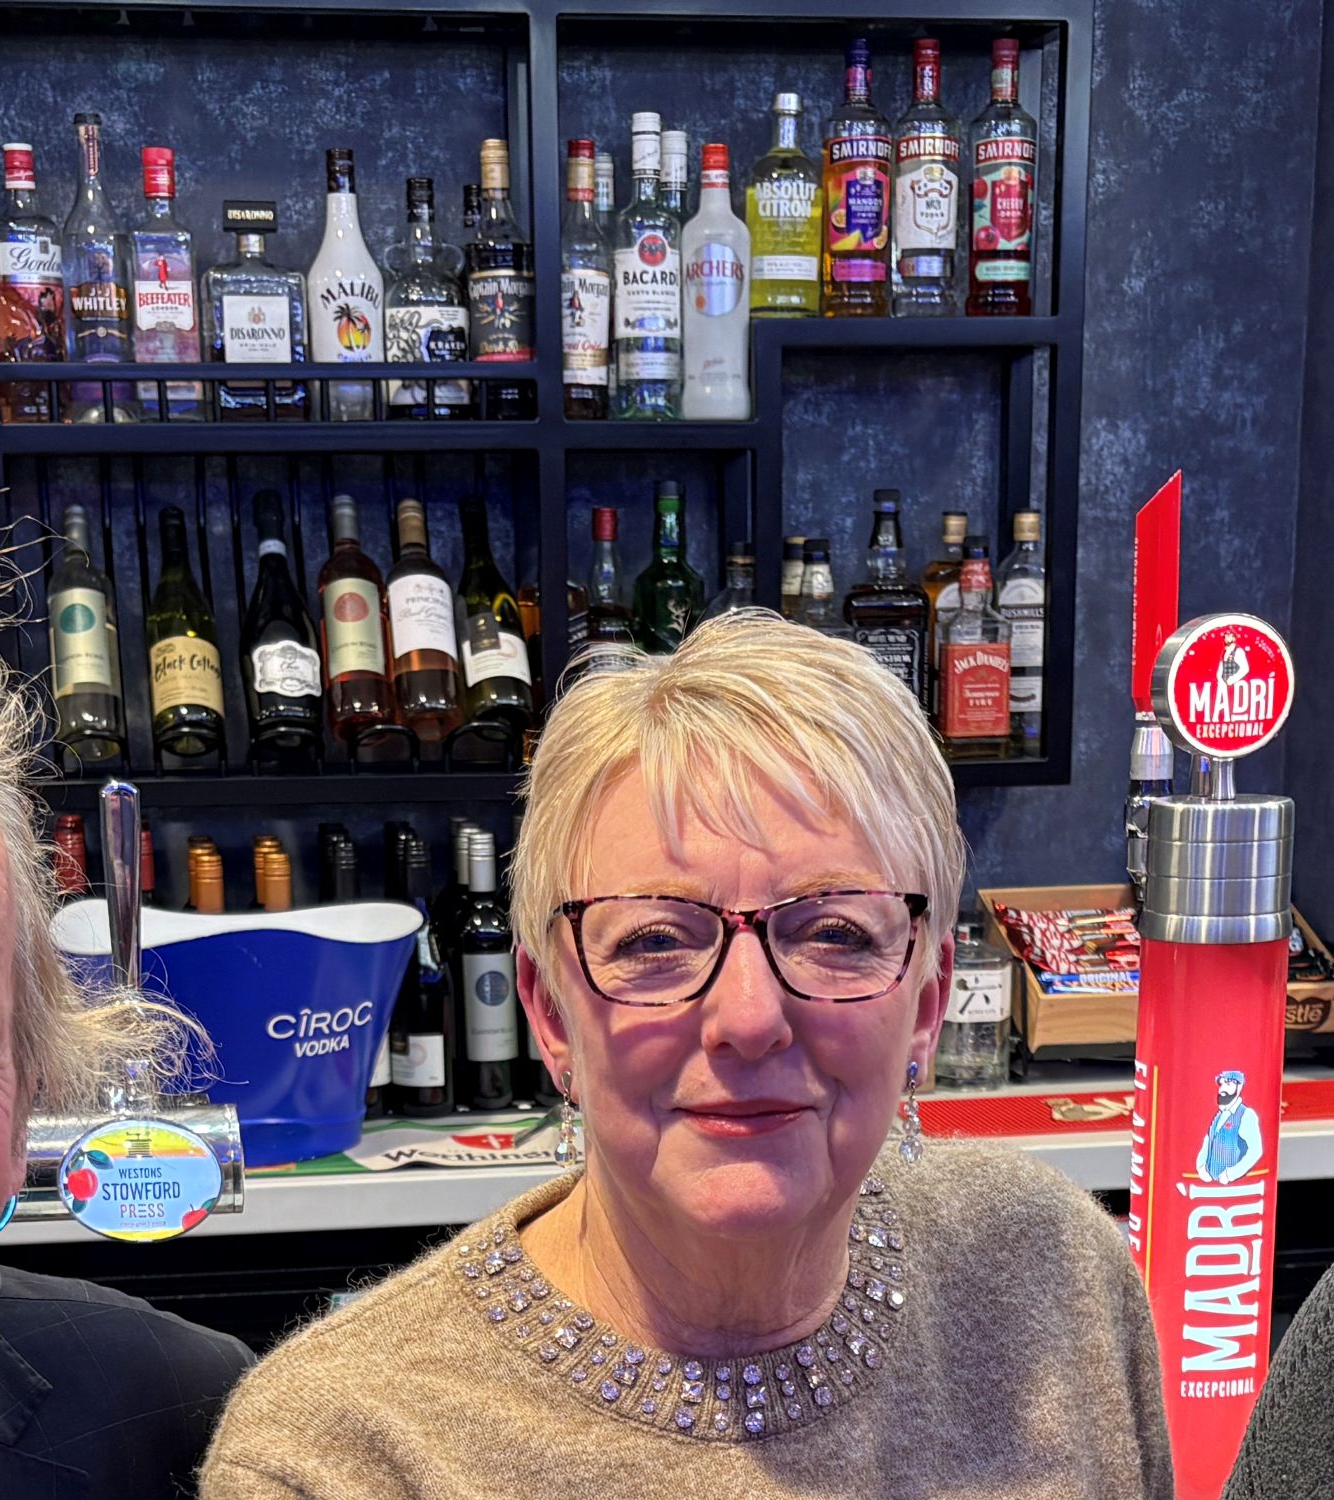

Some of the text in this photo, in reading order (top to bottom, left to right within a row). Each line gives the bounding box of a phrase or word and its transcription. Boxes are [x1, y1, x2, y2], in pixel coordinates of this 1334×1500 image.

[832, 140, 892, 160] SMIRNOFF
[899, 138, 959, 158] SMIRNOFF
[755, 180, 817, 200] ABSOLUT
[758, 199, 812, 218] CITRON
[9, 247, 61, 273] Gordo
[685, 259, 744, 282] ARCHERS
[72, 296, 127, 312] WHITLEY
[138, 292, 192, 308] BEEFEATER
[320, 282, 380, 310] MALIBU
[230, 327, 286, 341] DISARONNO
[954, 657, 977, 675] JACK
[1188, 671, 1276, 723] MADRÍ
[1196, 721, 1264, 739] EXCEPCIONAL
[267, 1000, 373, 1040] CÎROC
[1285, 1001, 1323, 1024] stlé
[295, 1034, 350, 1058] VODKA
[1128, 1058, 1148, 1252] EL ALMA DE
[118, 1167, 163, 1180] WESTONS
[101, 1181, 181, 1201] STOWFORD
[120, 1202, 165, 1219] PRESS
[1175, 1179, 1265, 1373] MADRÍ
[1180, 1377, 1255, 1398] EXCEPCIONAL
